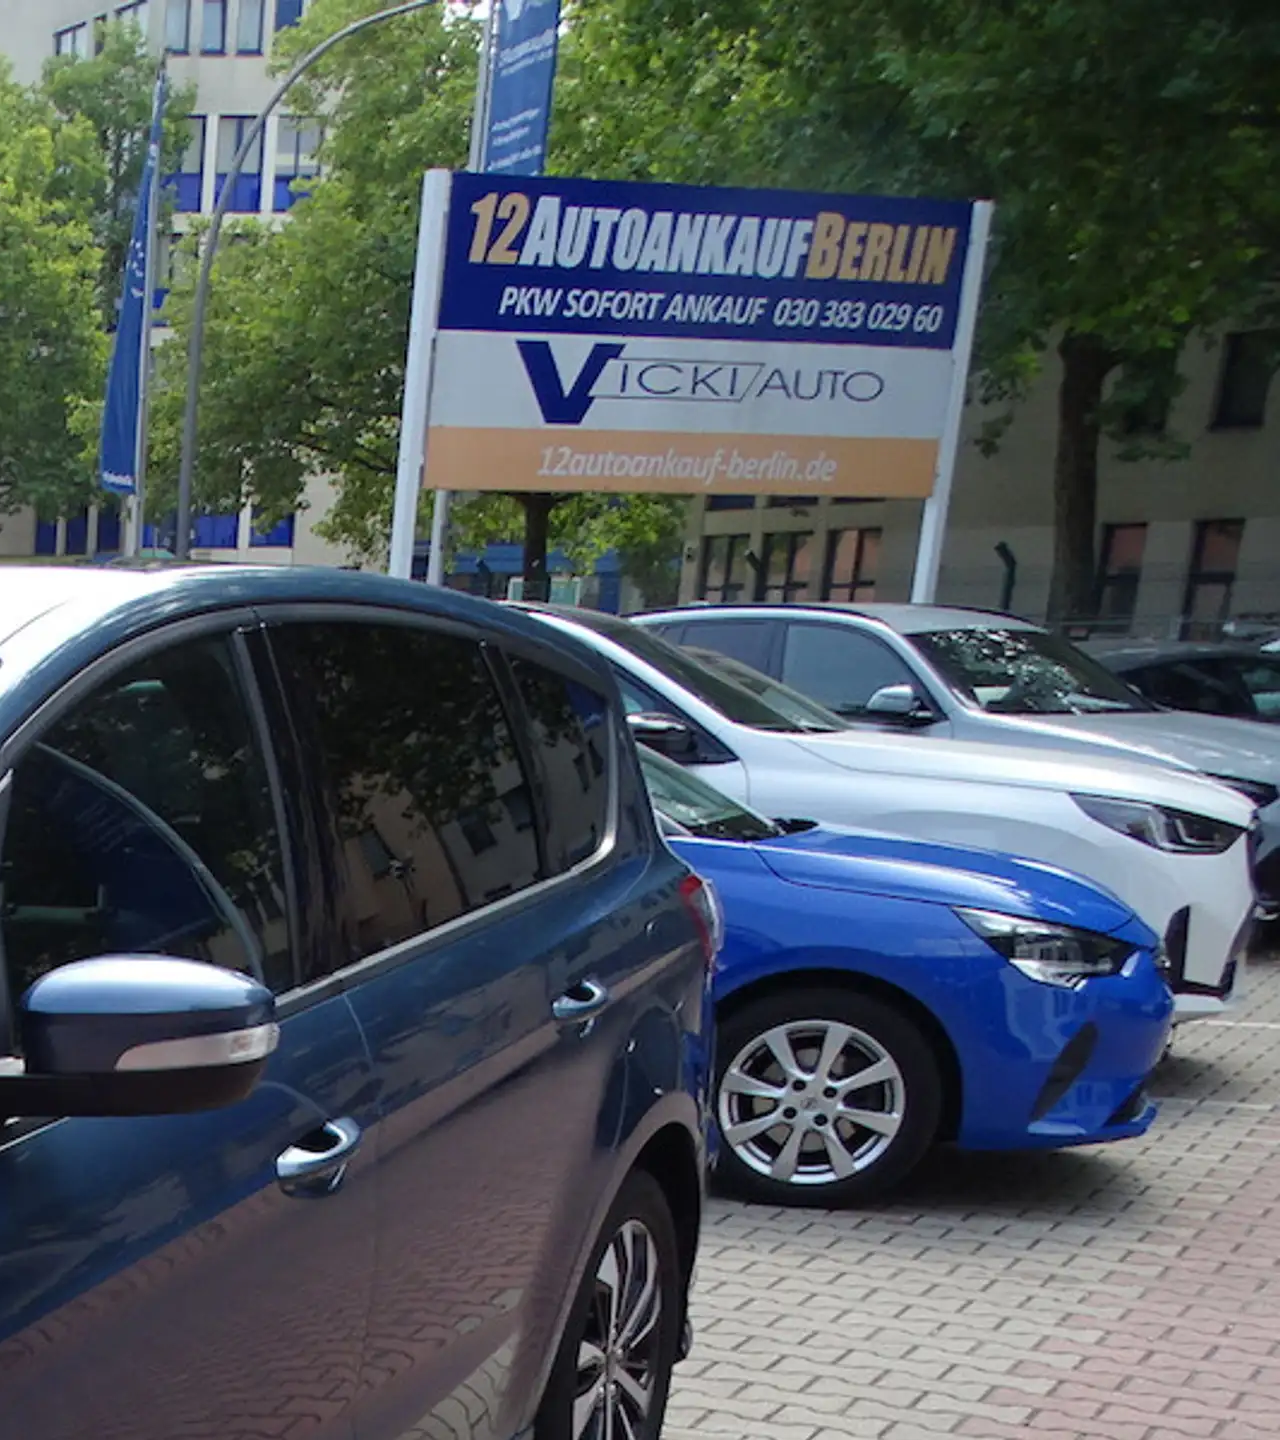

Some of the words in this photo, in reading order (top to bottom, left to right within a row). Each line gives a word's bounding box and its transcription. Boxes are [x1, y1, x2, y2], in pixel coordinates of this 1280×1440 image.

[499, 286, 562, 315] PKW
[562, 288, 665, 320] SOFORT
[662, 293, 767, 325] ANKAUF
[772, 298, 820, 327] 030
[820, 300, 865, 329] 383
[867, 302, 912, 332] 029
[912, 305, 943, 333] 60
[757, 367, 885, 402] AUTO
[537, 445, 838, 485] 12autoankauf-berlin.de
